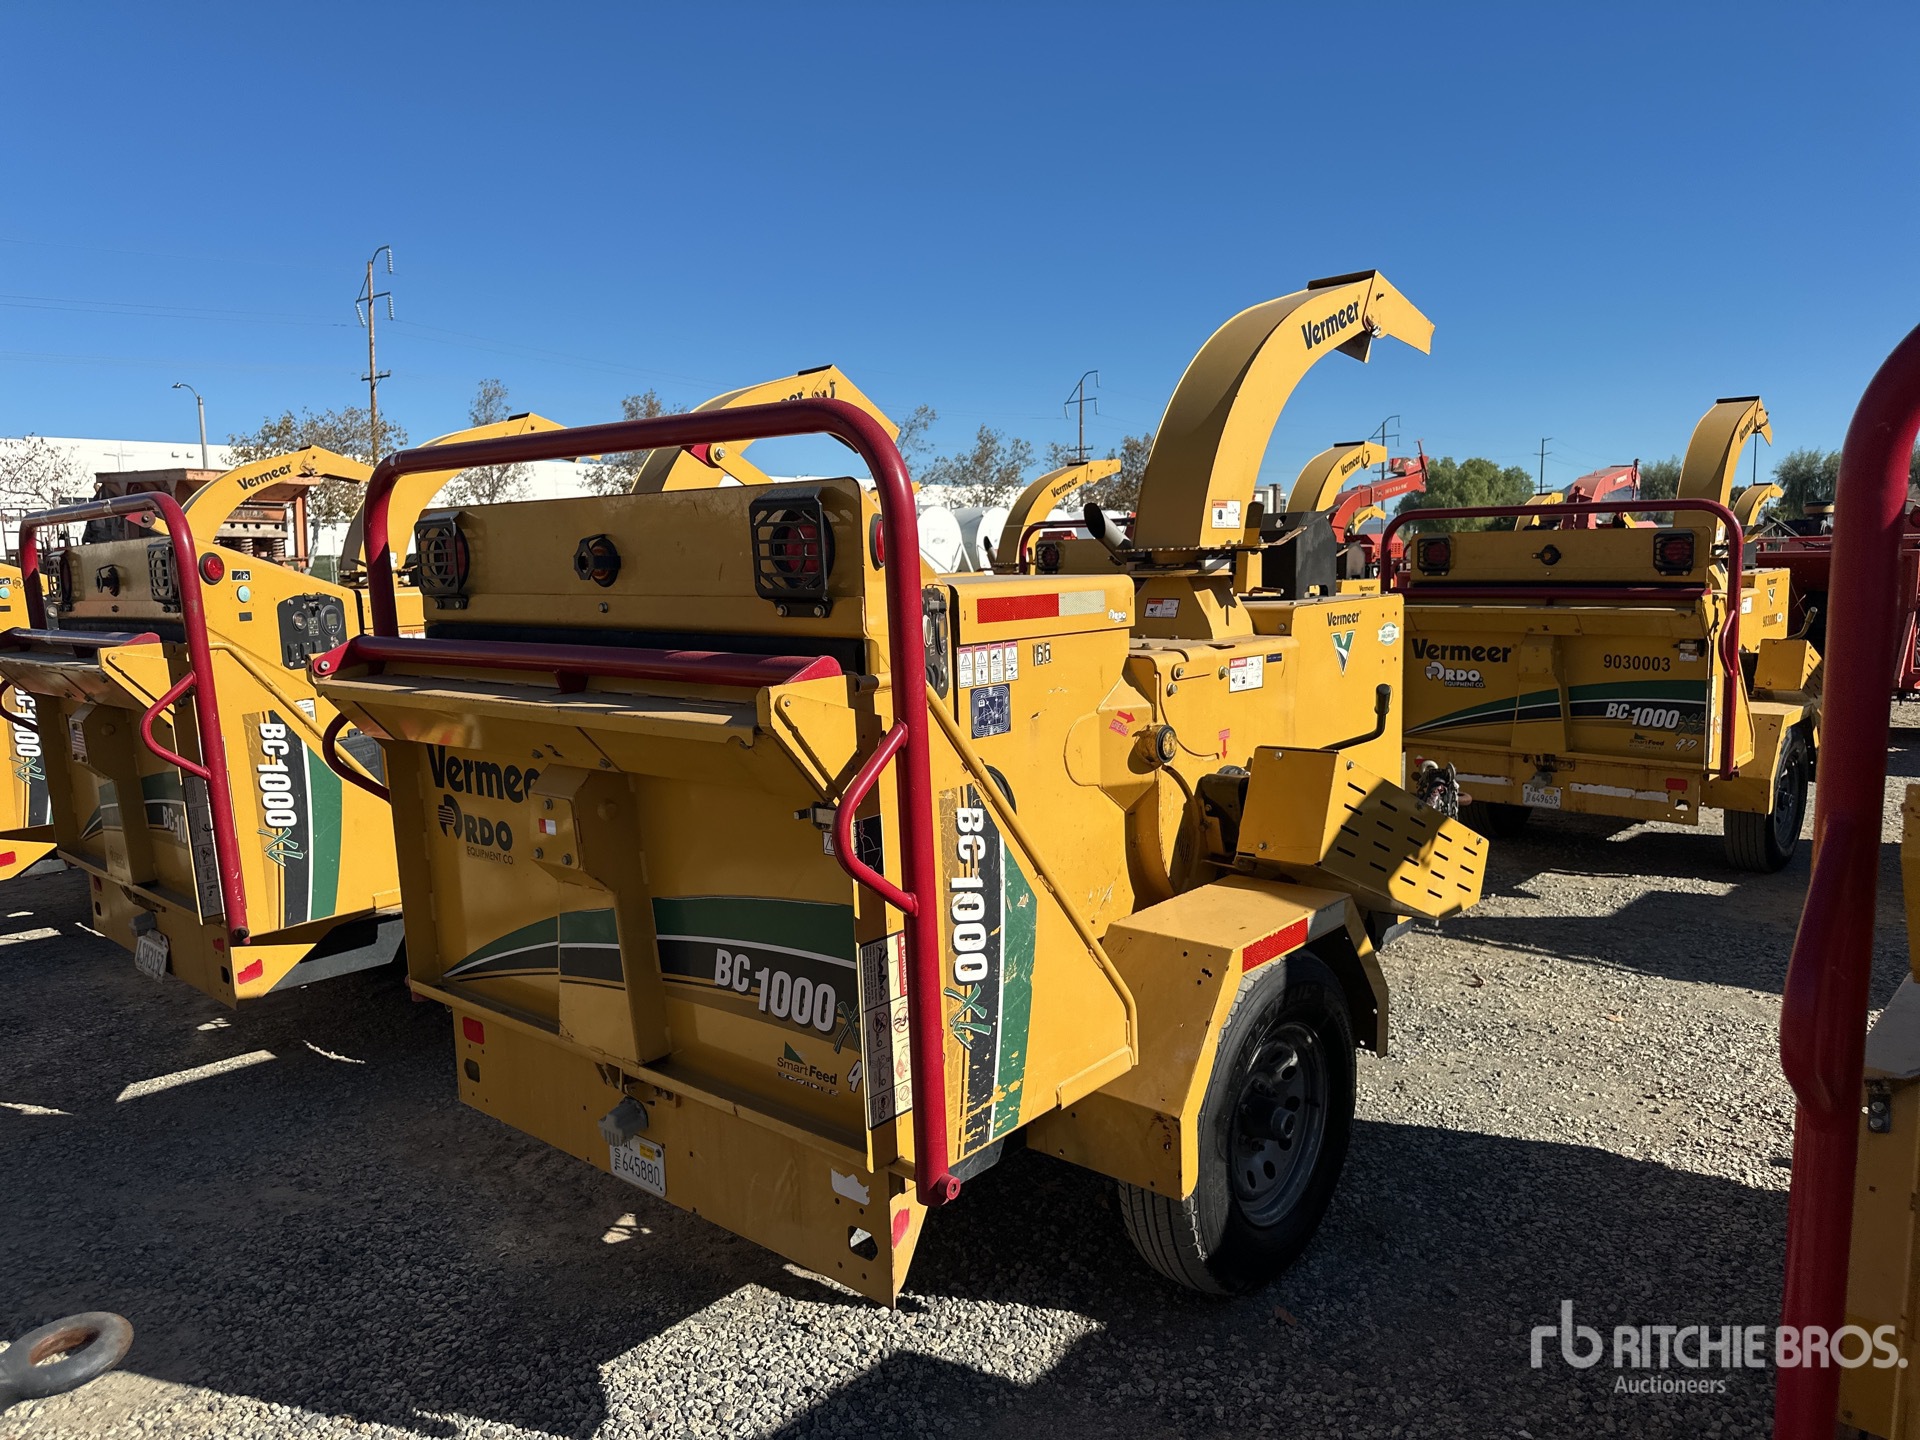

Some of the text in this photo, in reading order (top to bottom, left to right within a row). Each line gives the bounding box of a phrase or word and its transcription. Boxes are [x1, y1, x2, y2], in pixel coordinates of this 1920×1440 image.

[1300, 301, 1360, 350] Vermeer
[237, 463, 292, 490] Vermeer
[1340, 455, 1361, 476] Vermeer
[1051, 476, 1078, 498] Vermeer
[1326, 611, 1360, 627] Vermeer
[1411, 638, 1511, 663] Vermeer
[1603, 654, 1671, 672] 9030003
[426, 744, 541, 804] Verme
[162, 804, 188, 844] BC10
[466, 845, 502, 863] EQUIPMENT
[777, 1055, 838, 1087] SmartFeed
[622, 1152, 660, 1186] 645880
